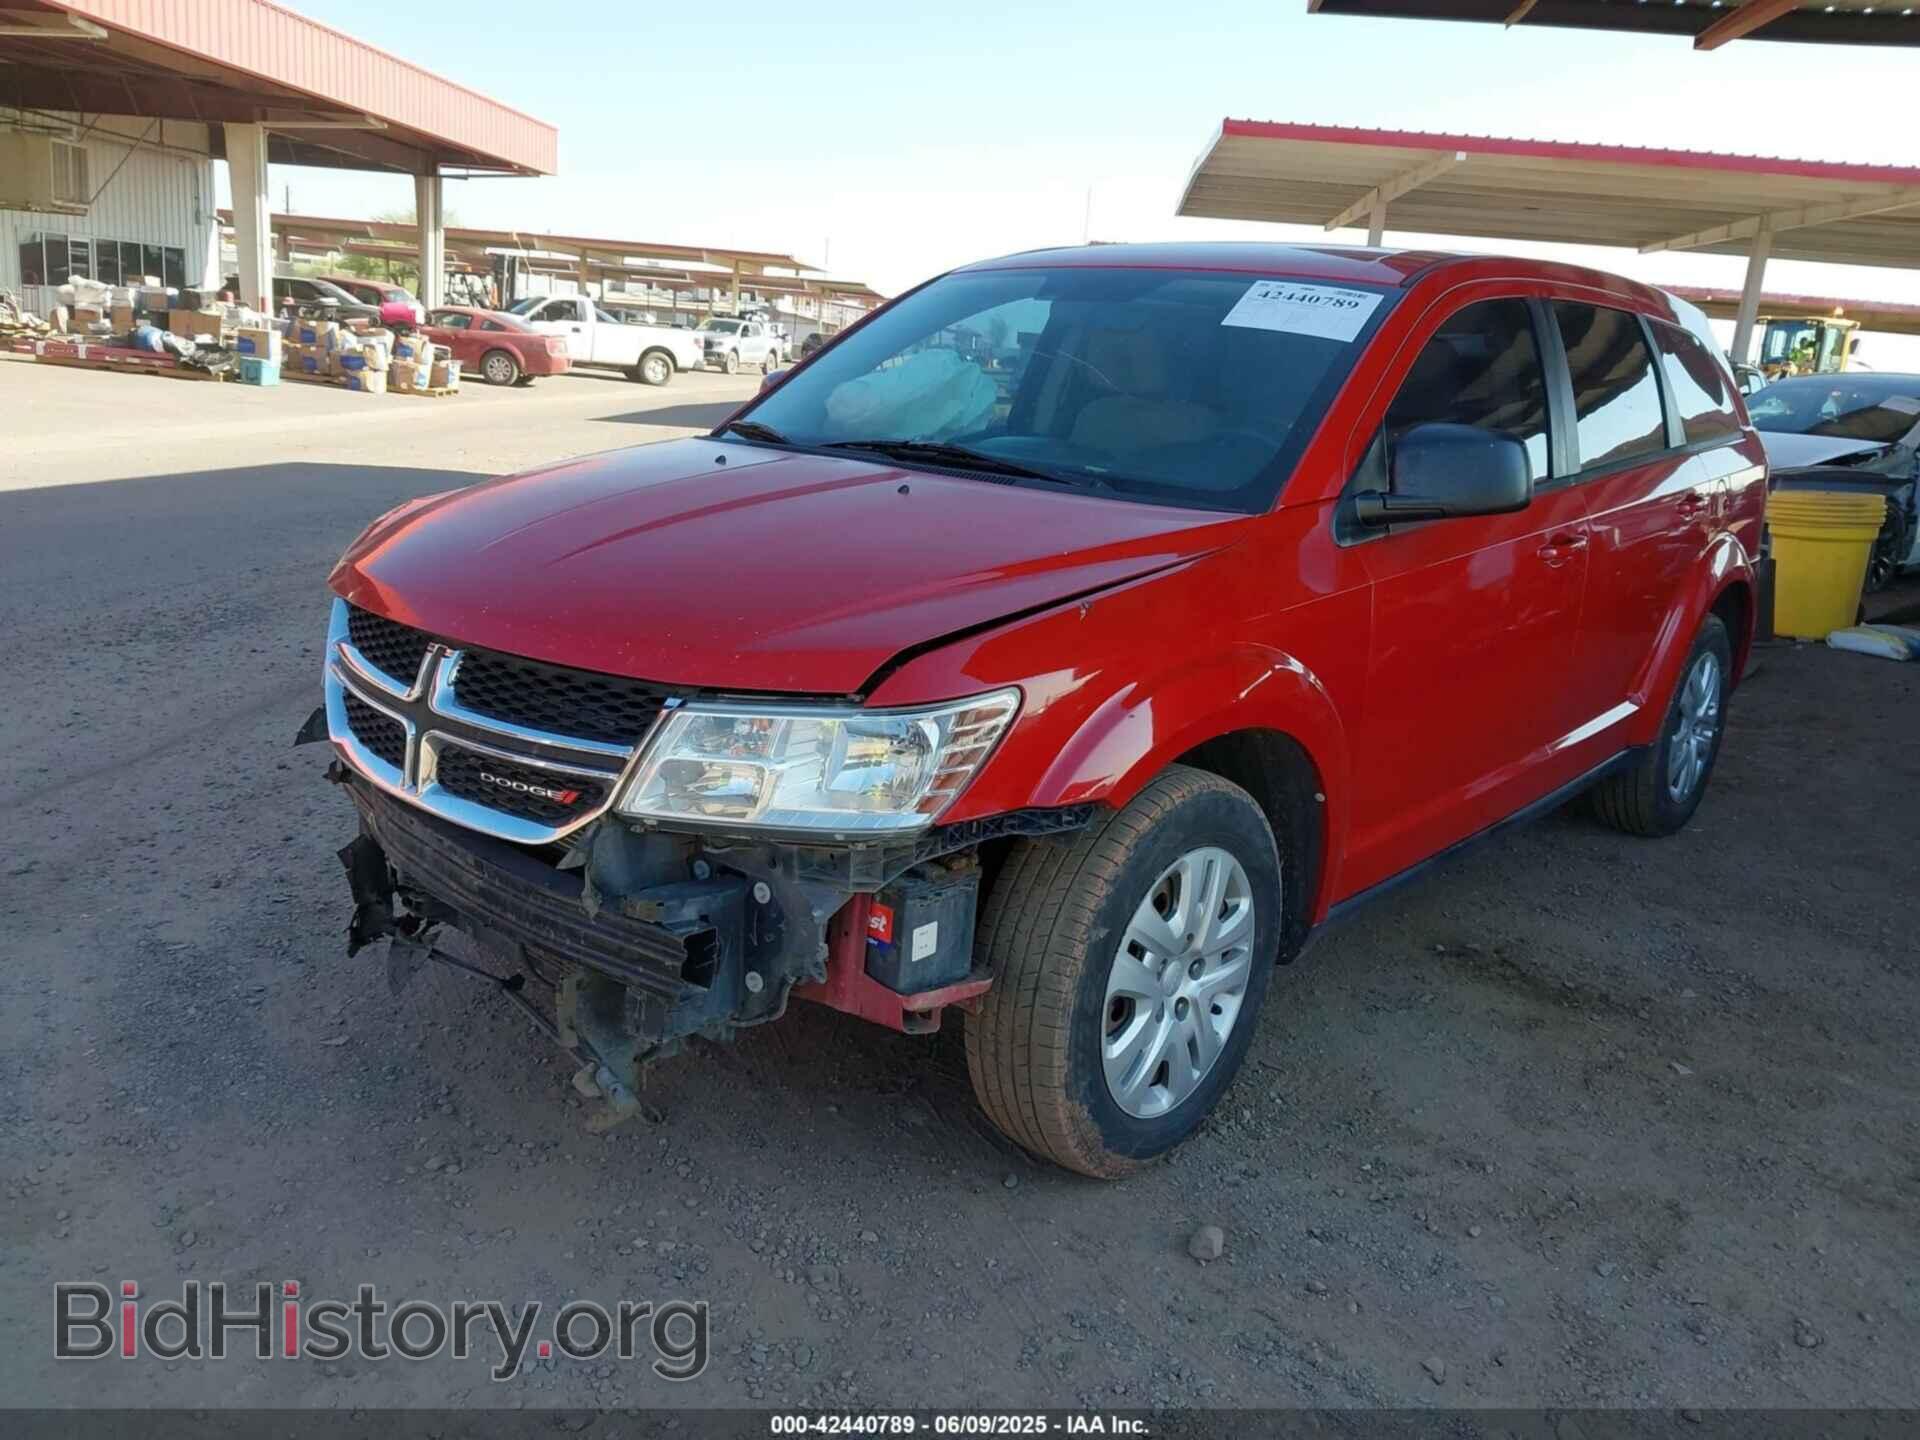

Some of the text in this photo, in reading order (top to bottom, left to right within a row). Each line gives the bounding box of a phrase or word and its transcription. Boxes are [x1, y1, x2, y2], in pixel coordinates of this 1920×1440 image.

[1257, 290, 1360, 310] 42440789
[480, 772, 563, 802] DODGE
[867, 913, 888, 932] st
